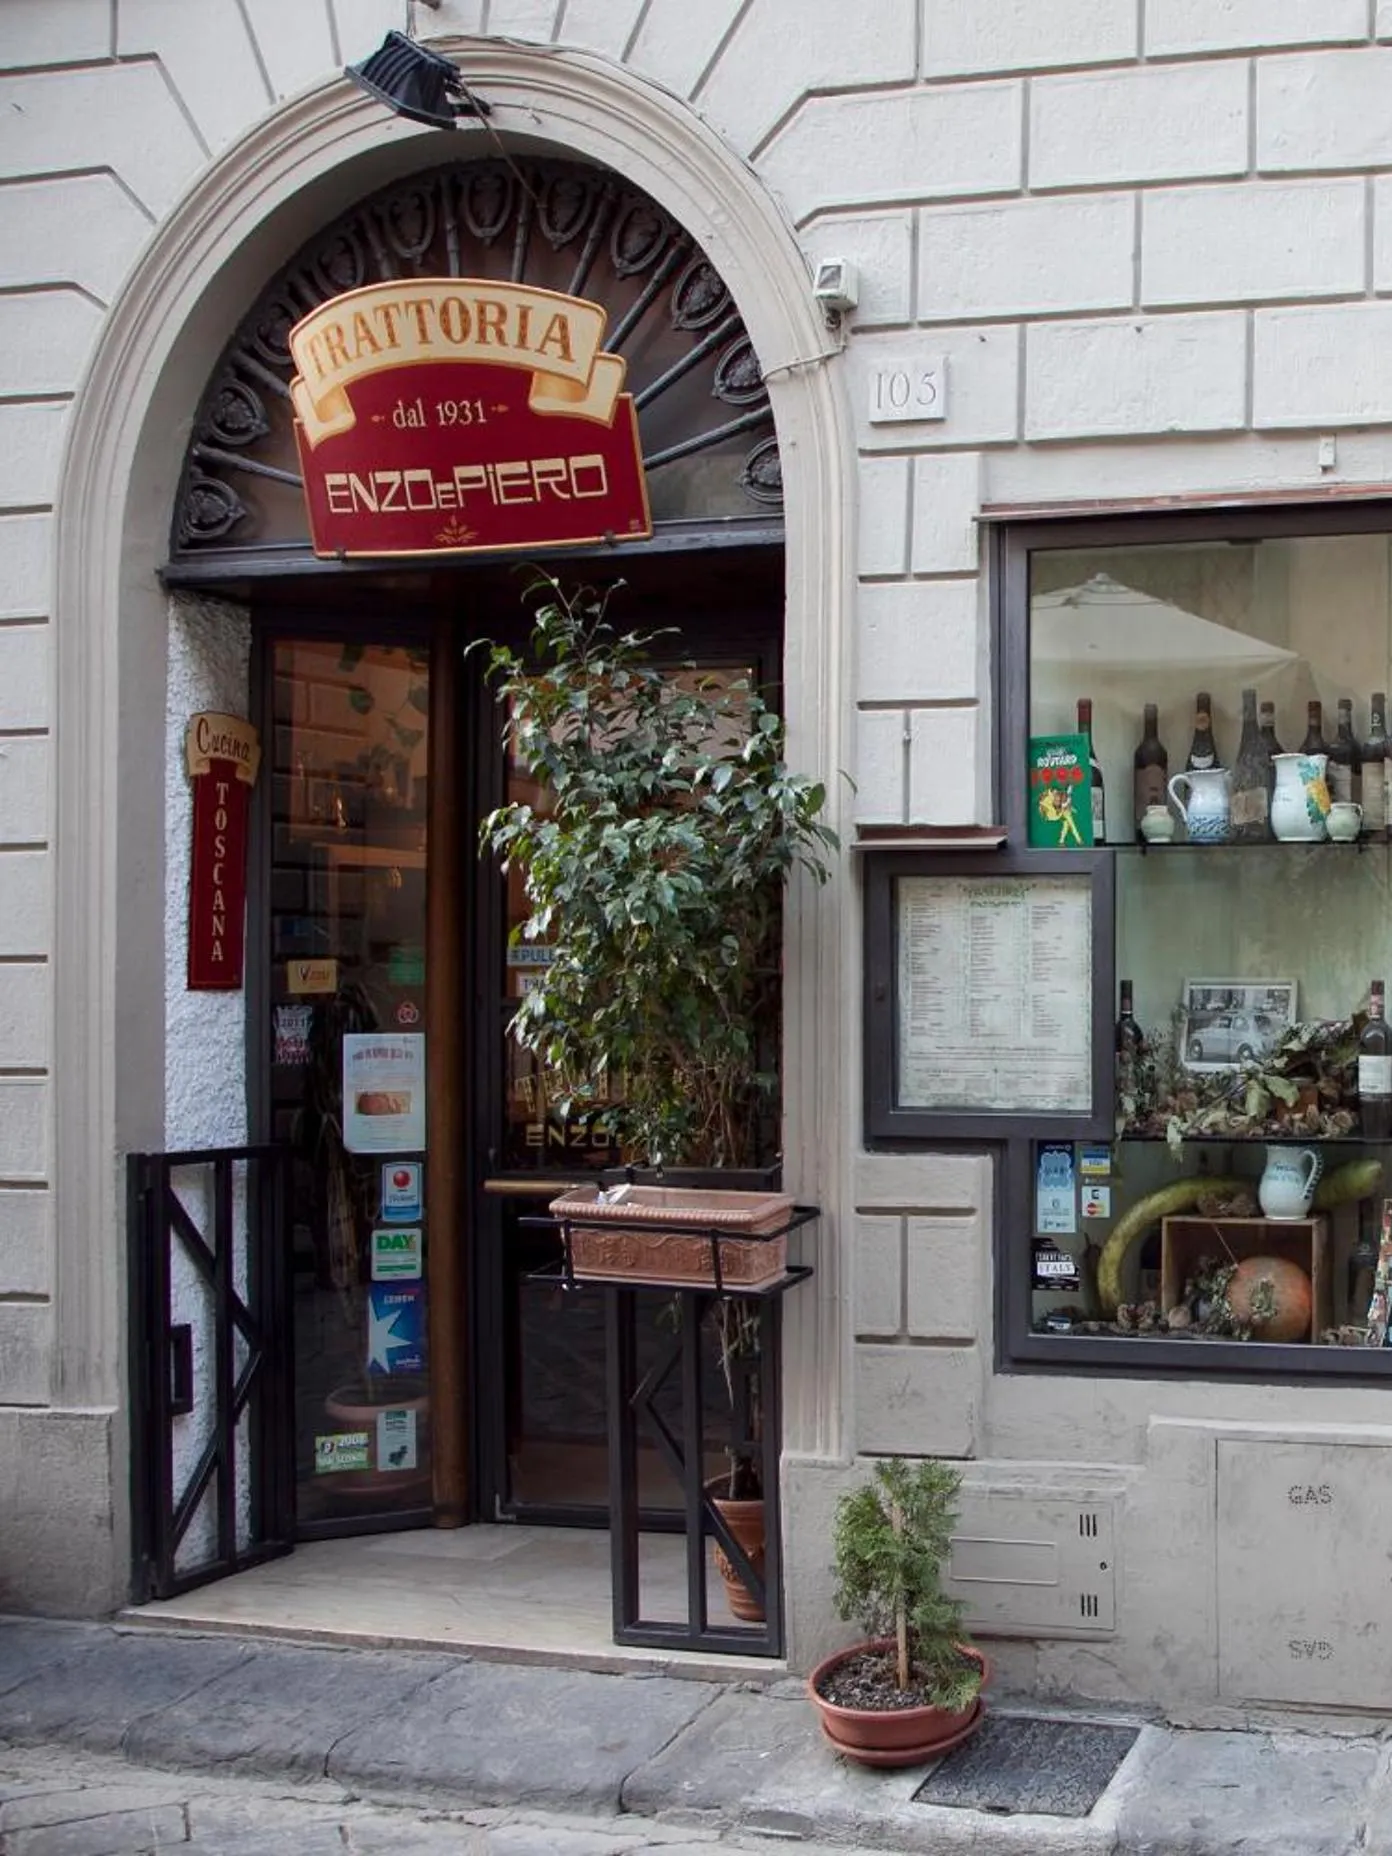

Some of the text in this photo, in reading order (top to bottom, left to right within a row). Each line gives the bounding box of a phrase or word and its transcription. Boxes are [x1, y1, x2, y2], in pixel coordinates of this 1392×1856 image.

[303, 296, 576, 380] TRATTORIA
[875, 370, 937, 409] 105
[393, 398, 487, 429] dal 1931
[195, 717, 250, 760] Cucina
[211, 781, 230, 962] TOSCANA
[526, 1122, 610, 1148] ENZO
[1288, 1484, 1332, 1505] GAS
